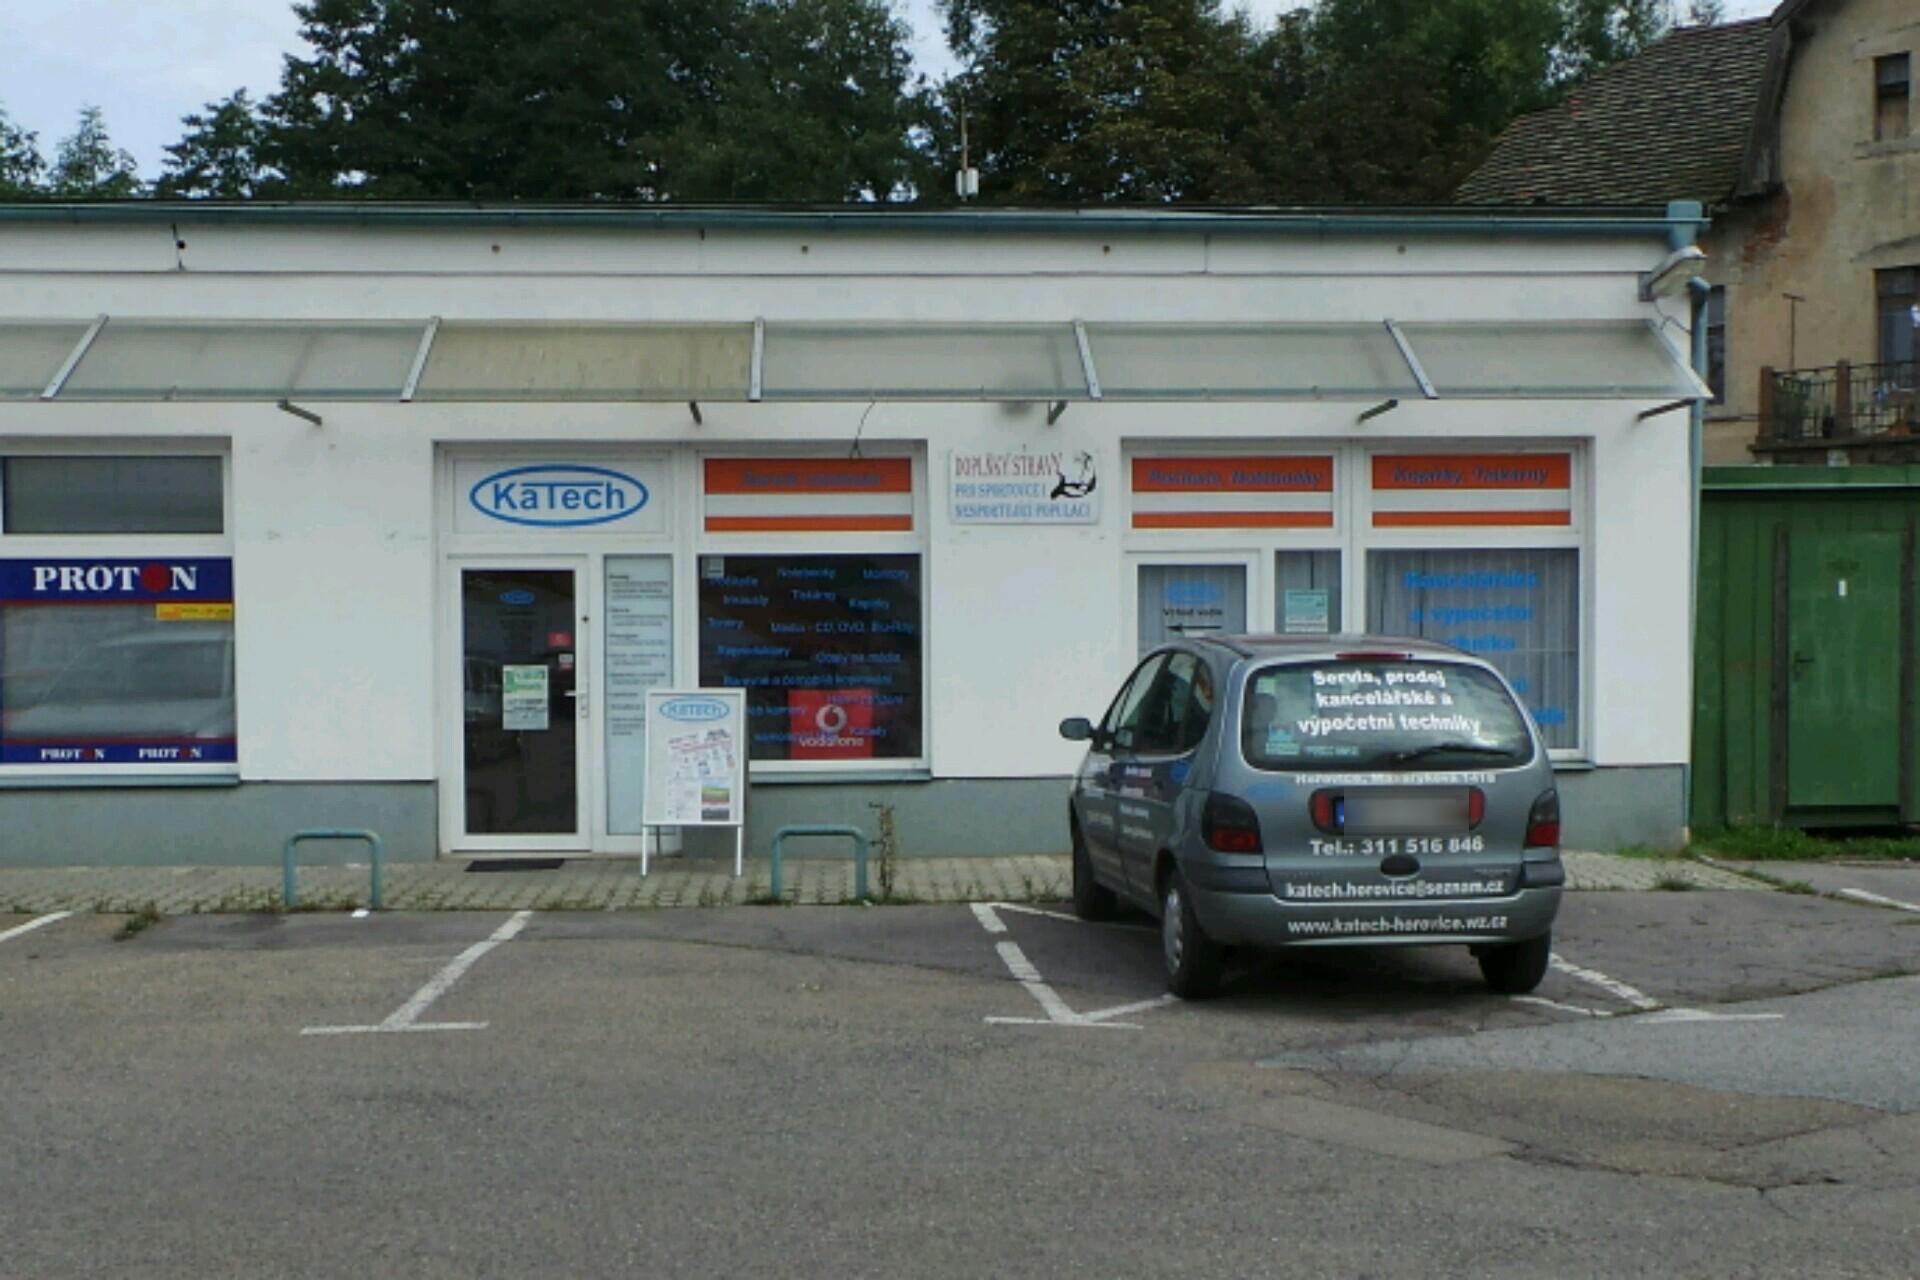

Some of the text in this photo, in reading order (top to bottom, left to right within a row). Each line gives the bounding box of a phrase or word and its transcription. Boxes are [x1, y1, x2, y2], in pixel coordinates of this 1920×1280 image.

[493, 481, 626, 510] KaTech
[33, 564, 197, 592] PROTON
[1385, 669, 1446, 688] prodej
[1441, 695, 1453, 706] a
[1400, 713, 1482, 735] techniky
[1360, 838, 1398, 854] 311
[1405, 837, 1443, 854] 516
